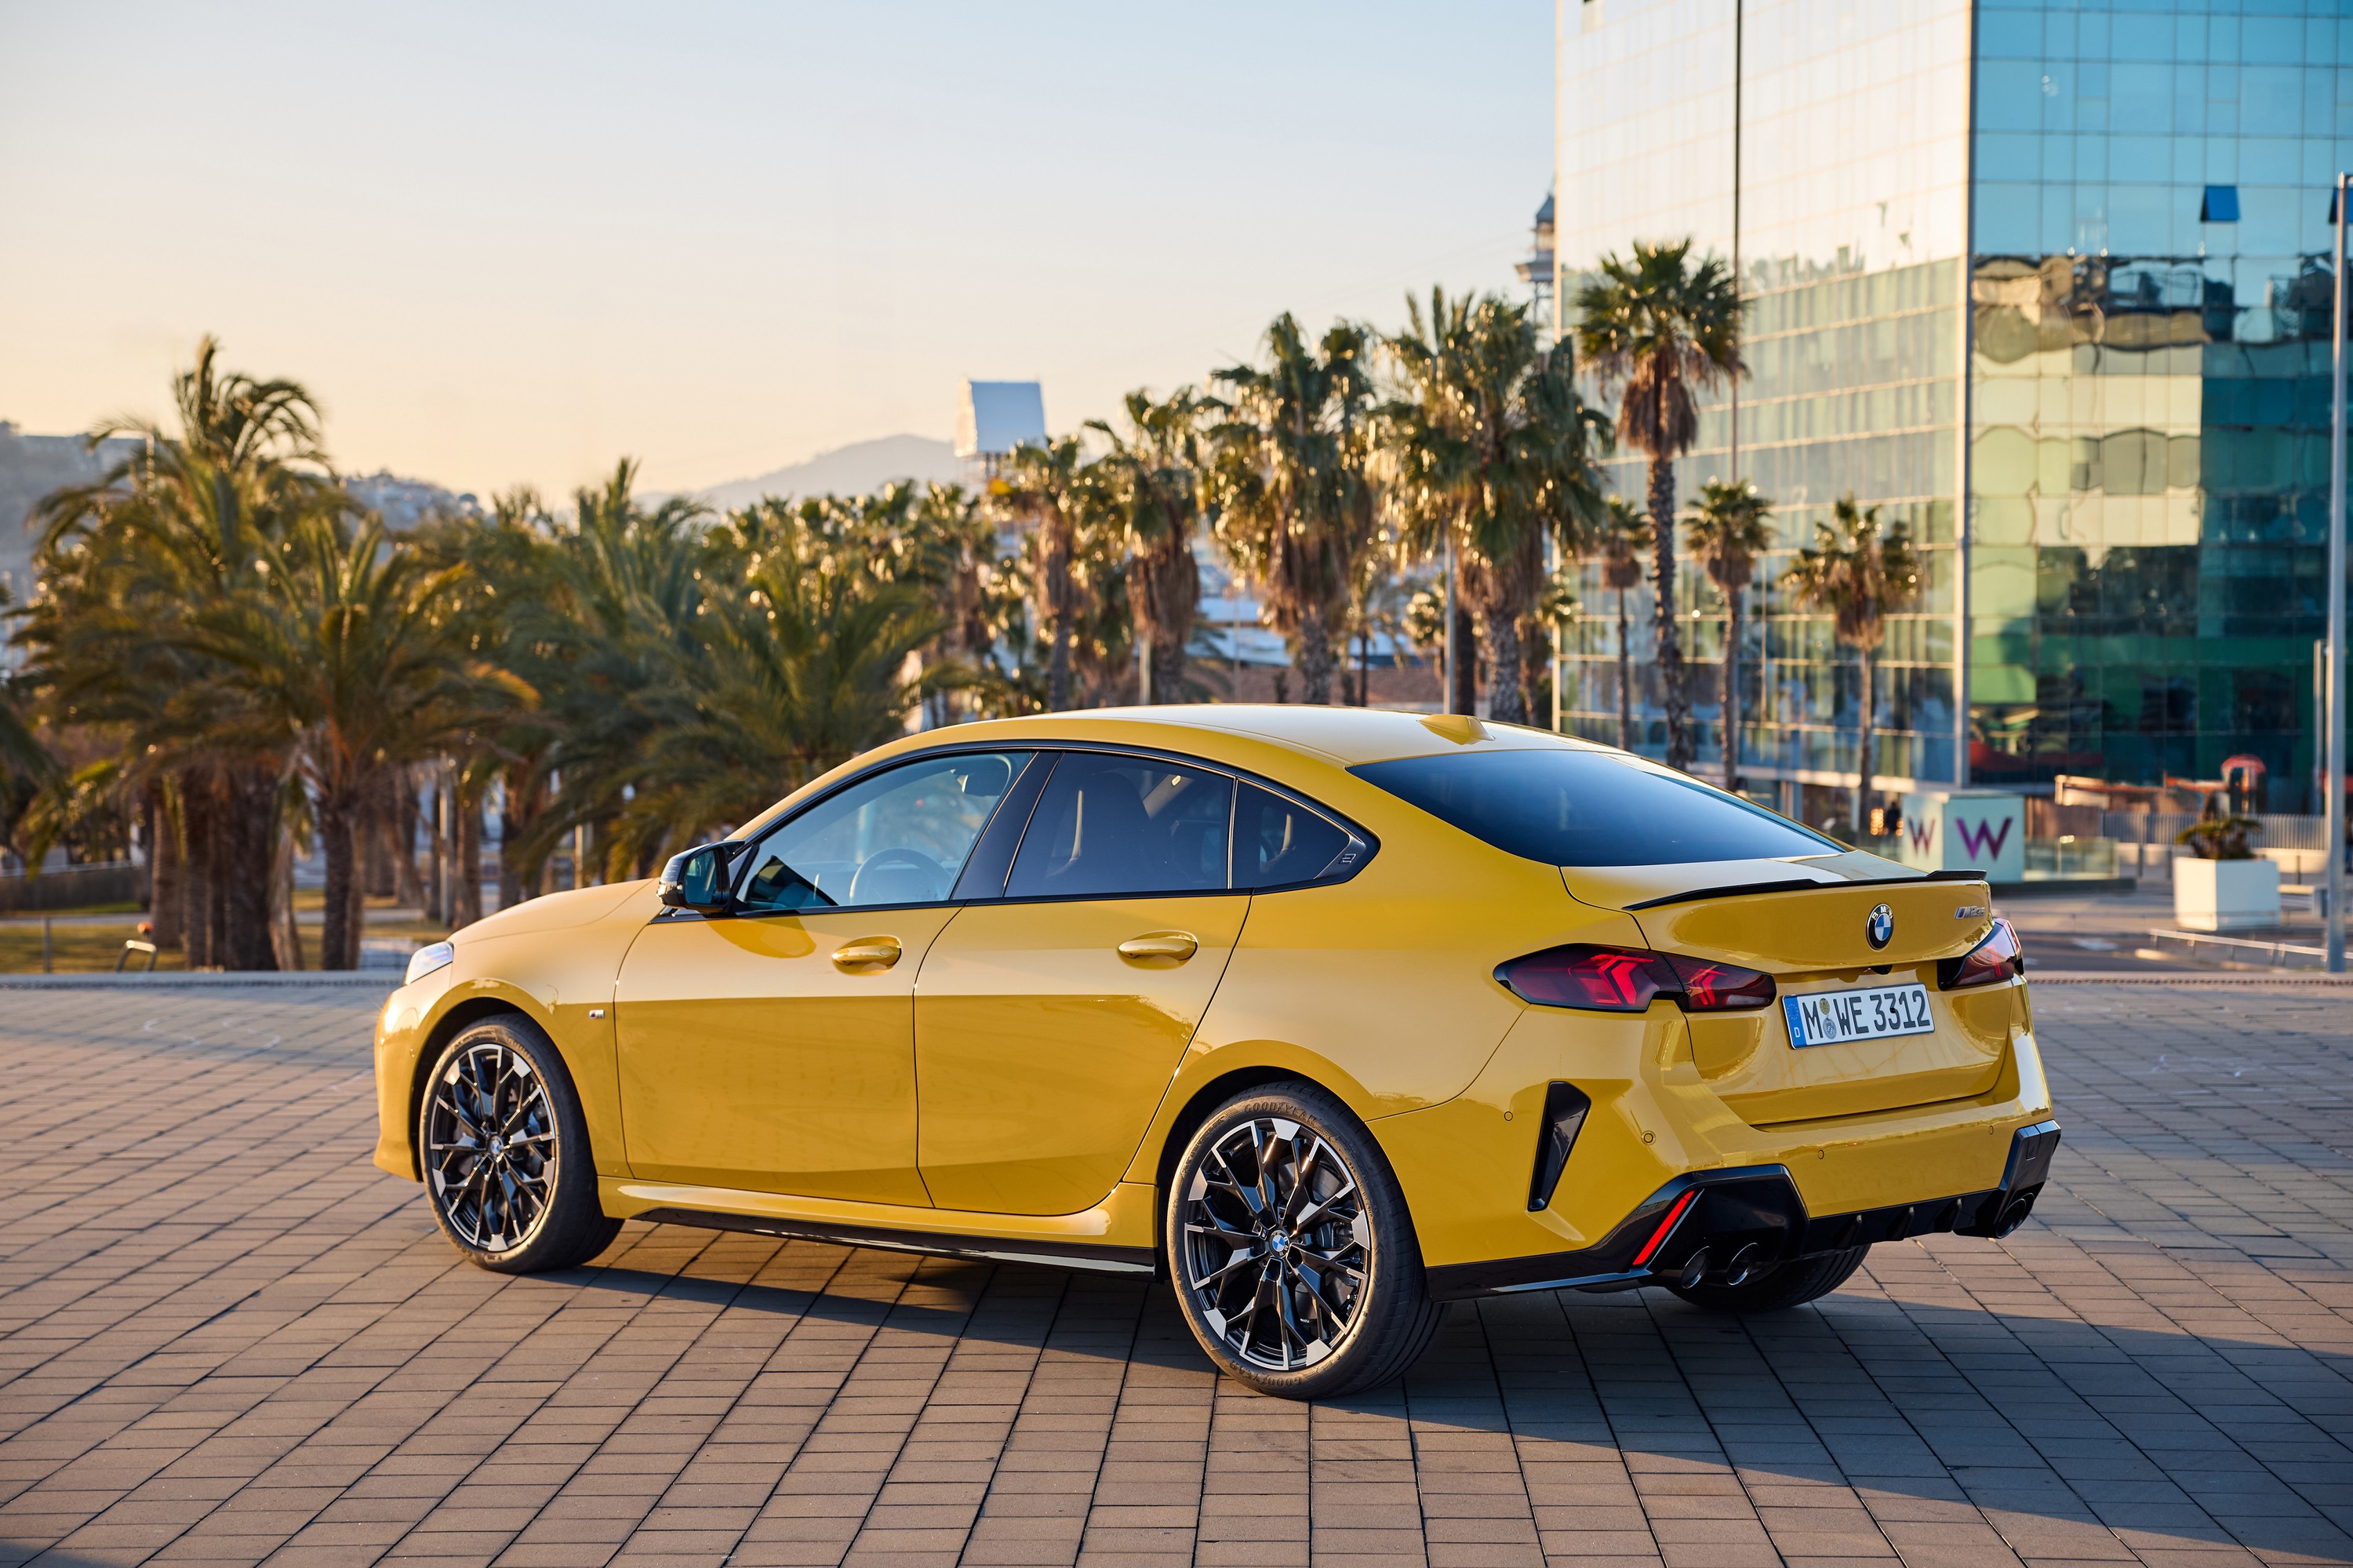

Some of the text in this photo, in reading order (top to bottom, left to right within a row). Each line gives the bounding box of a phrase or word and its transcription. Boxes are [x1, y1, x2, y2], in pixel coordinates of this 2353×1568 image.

[1907, 816, 1935, 858] W
[1956, 816, 2013, 861] W
[1794, 1027, 1801, 1038] D
[1802, 990, 1930, 1039] M WE 3312
[1245, 1101, 1317, 1126] GOODYEAR
